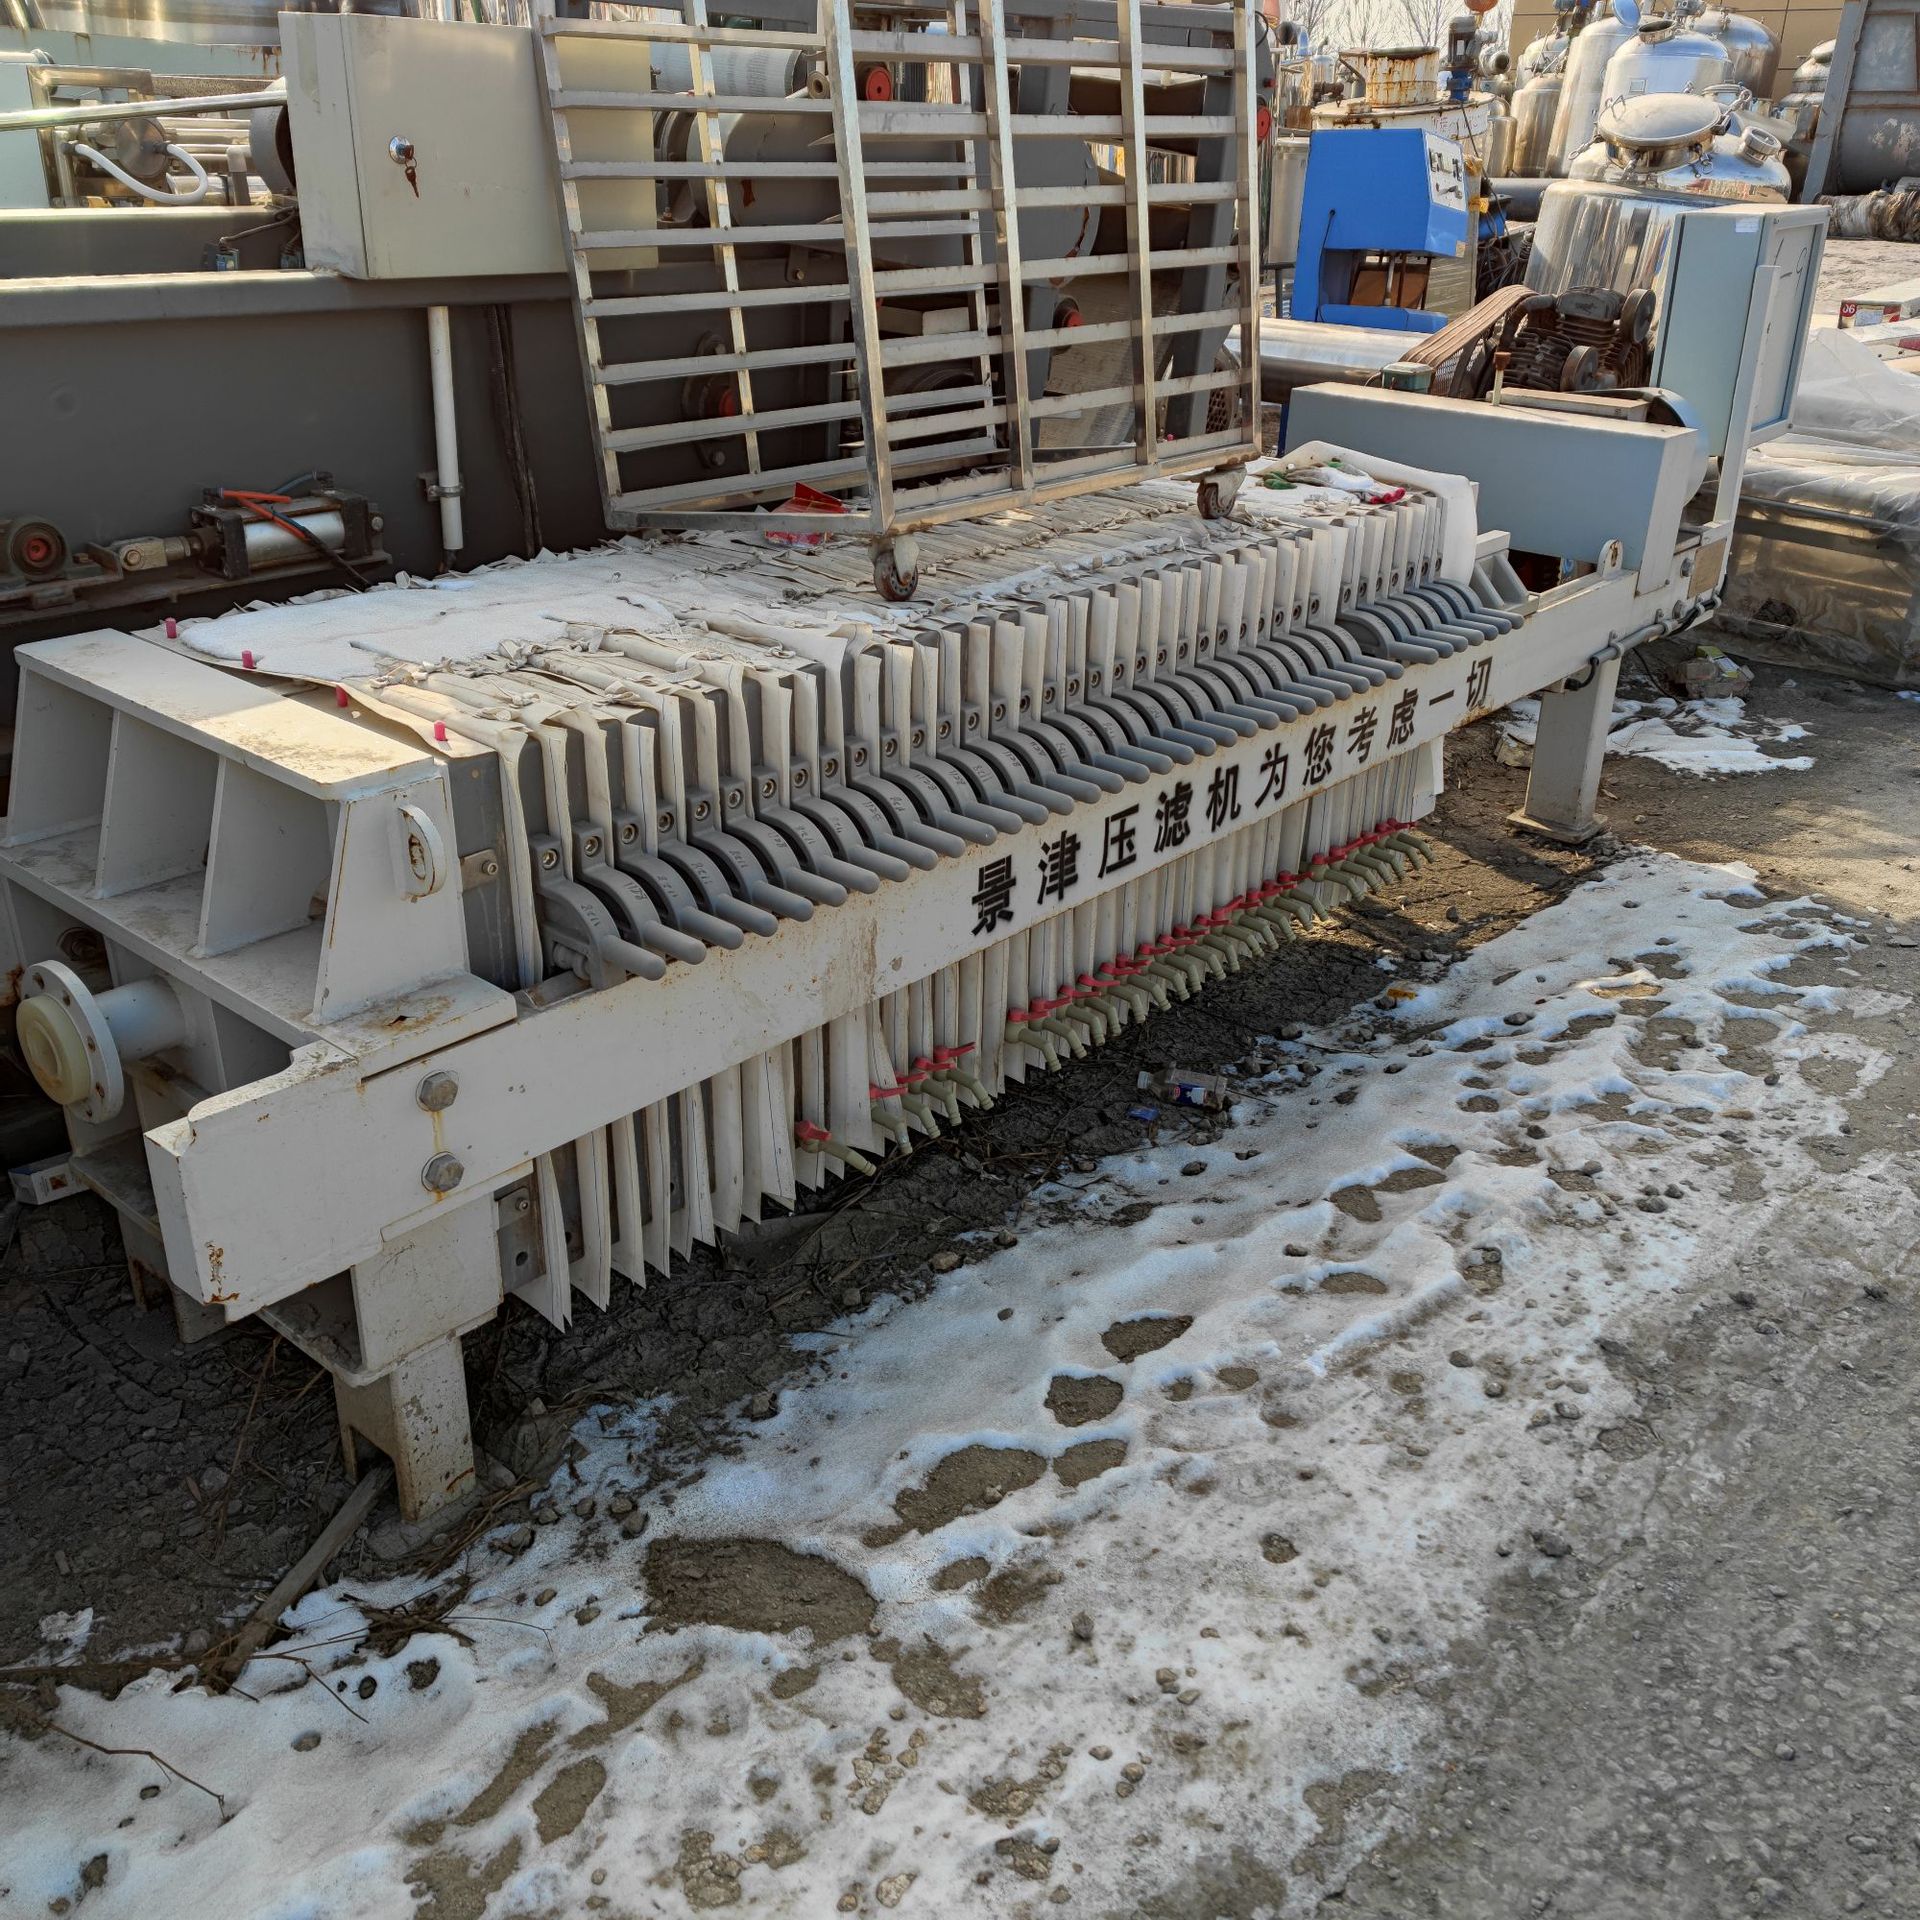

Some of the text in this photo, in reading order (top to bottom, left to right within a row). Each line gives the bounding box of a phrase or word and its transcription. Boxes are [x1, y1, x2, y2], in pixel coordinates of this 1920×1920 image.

[972, 656, 1493, 936] 景津压滤机为您考虑一切
